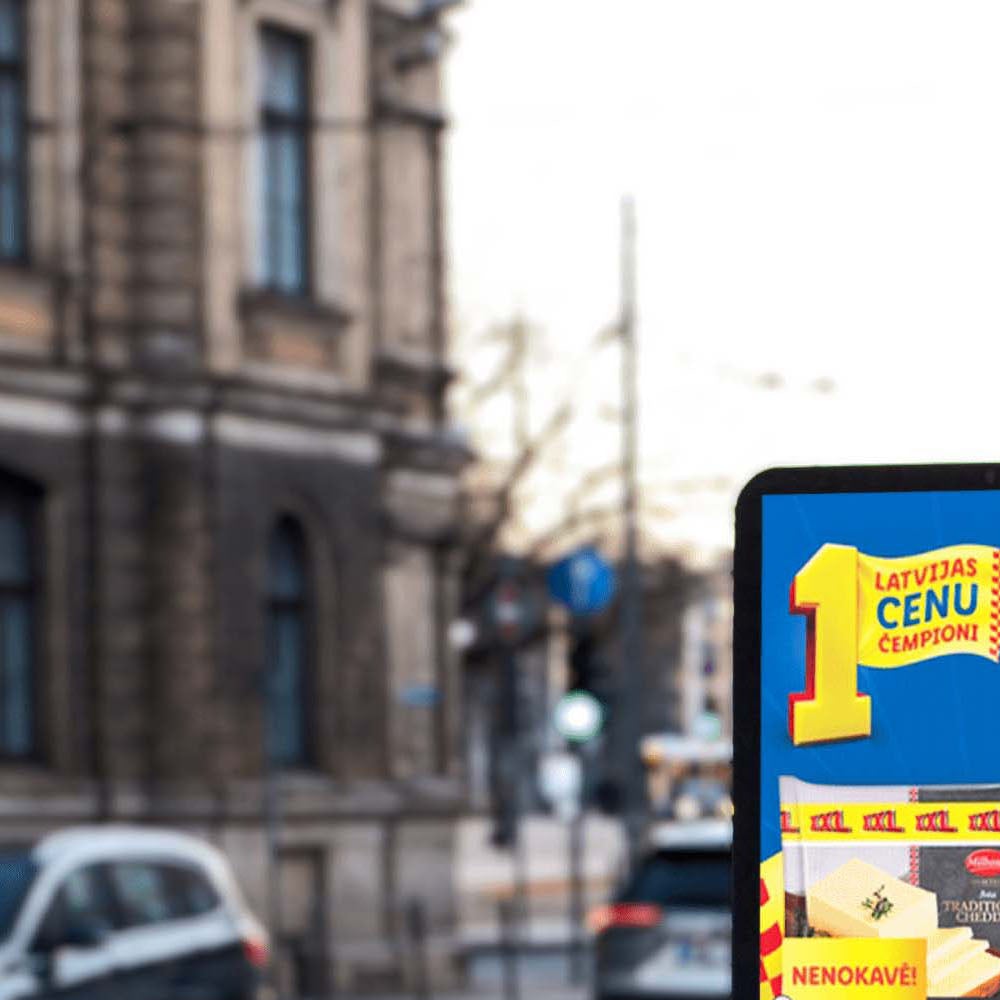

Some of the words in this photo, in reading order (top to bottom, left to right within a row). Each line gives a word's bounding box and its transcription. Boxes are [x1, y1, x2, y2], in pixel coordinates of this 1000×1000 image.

[875, 558, 977, 591] LATVIJAS
[877, 583, 978, 629] CENU
[788, 543, 871, 746] 1
[878, 624, 978, 653] ČEMPIONI
[810, 810, 852, 833] XXL
[863, 810, 905, 833] XXL
[915, 810, 958, 833] XXL
